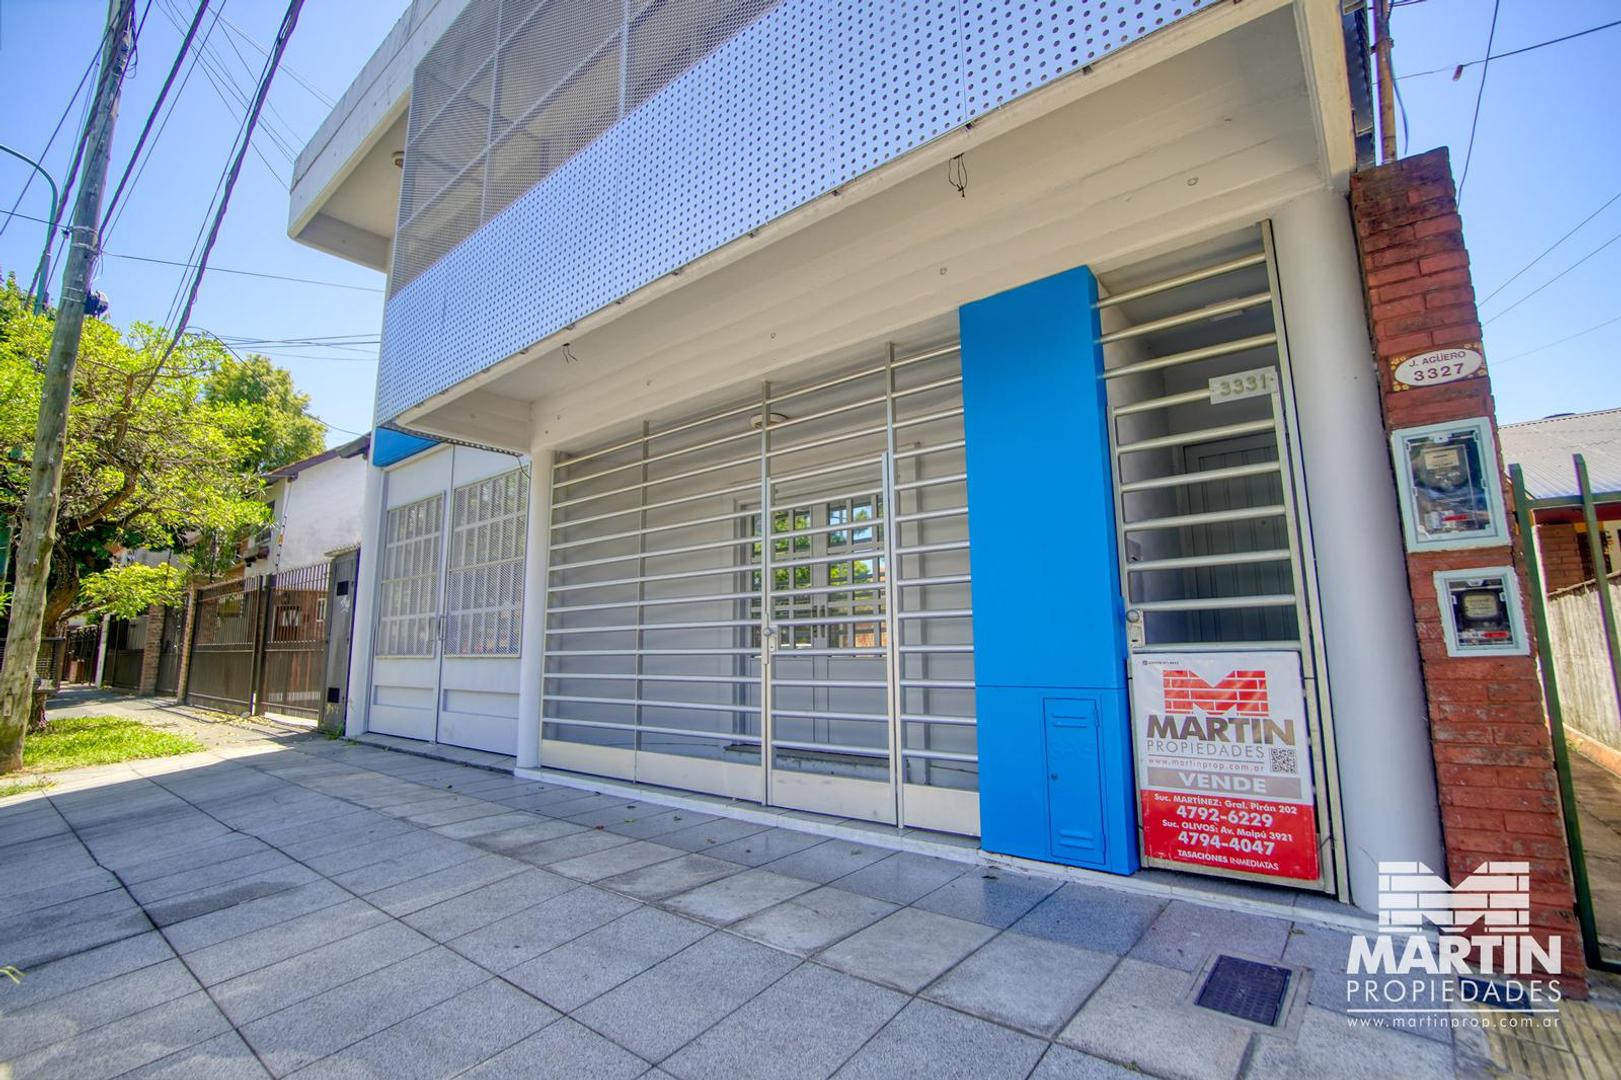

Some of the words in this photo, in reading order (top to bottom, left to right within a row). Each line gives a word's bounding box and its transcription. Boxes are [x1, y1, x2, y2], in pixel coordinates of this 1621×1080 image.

[1422, 351, 1466, 365] AGÜERO
[1413, 362, 1464, 382] 3327
[1220, 373, 1267, 396] 3331
[1146, 714, 1296, 746] MARTIN
[1147, 740, 1265, 758] PROPIEDADES
[1148, 758, 1265, 772] www.martinprop.com.ar
[1178, 772, 1267, 793] VENDE
[1154, 793, 1171, 802] Suc.
[1173, 794, 1222, 807] MARTÍNEZ:
[1225, 800, 1248, 809] Gral.
[1250, 802, 1277, 813] Pirán
[1279, 806, 1298, 815] 202
[1176, 805, 1274, 827] 4792-6229
[1162, 819, 1179, 828] Suc.
[1181, 821, 1219, 833] OLIVOS:
[1220, 826, 1234, 835] Av.
[1237, 828, 1267, 839] Maipú
[1269, 832, 1293, 842] 3921
[1177, 831, 1275, 856] 4794-4047
[1177, 849, 1228, 864] TASACIONES
[1230, 857, 1279, 871] INMEDIATAS
